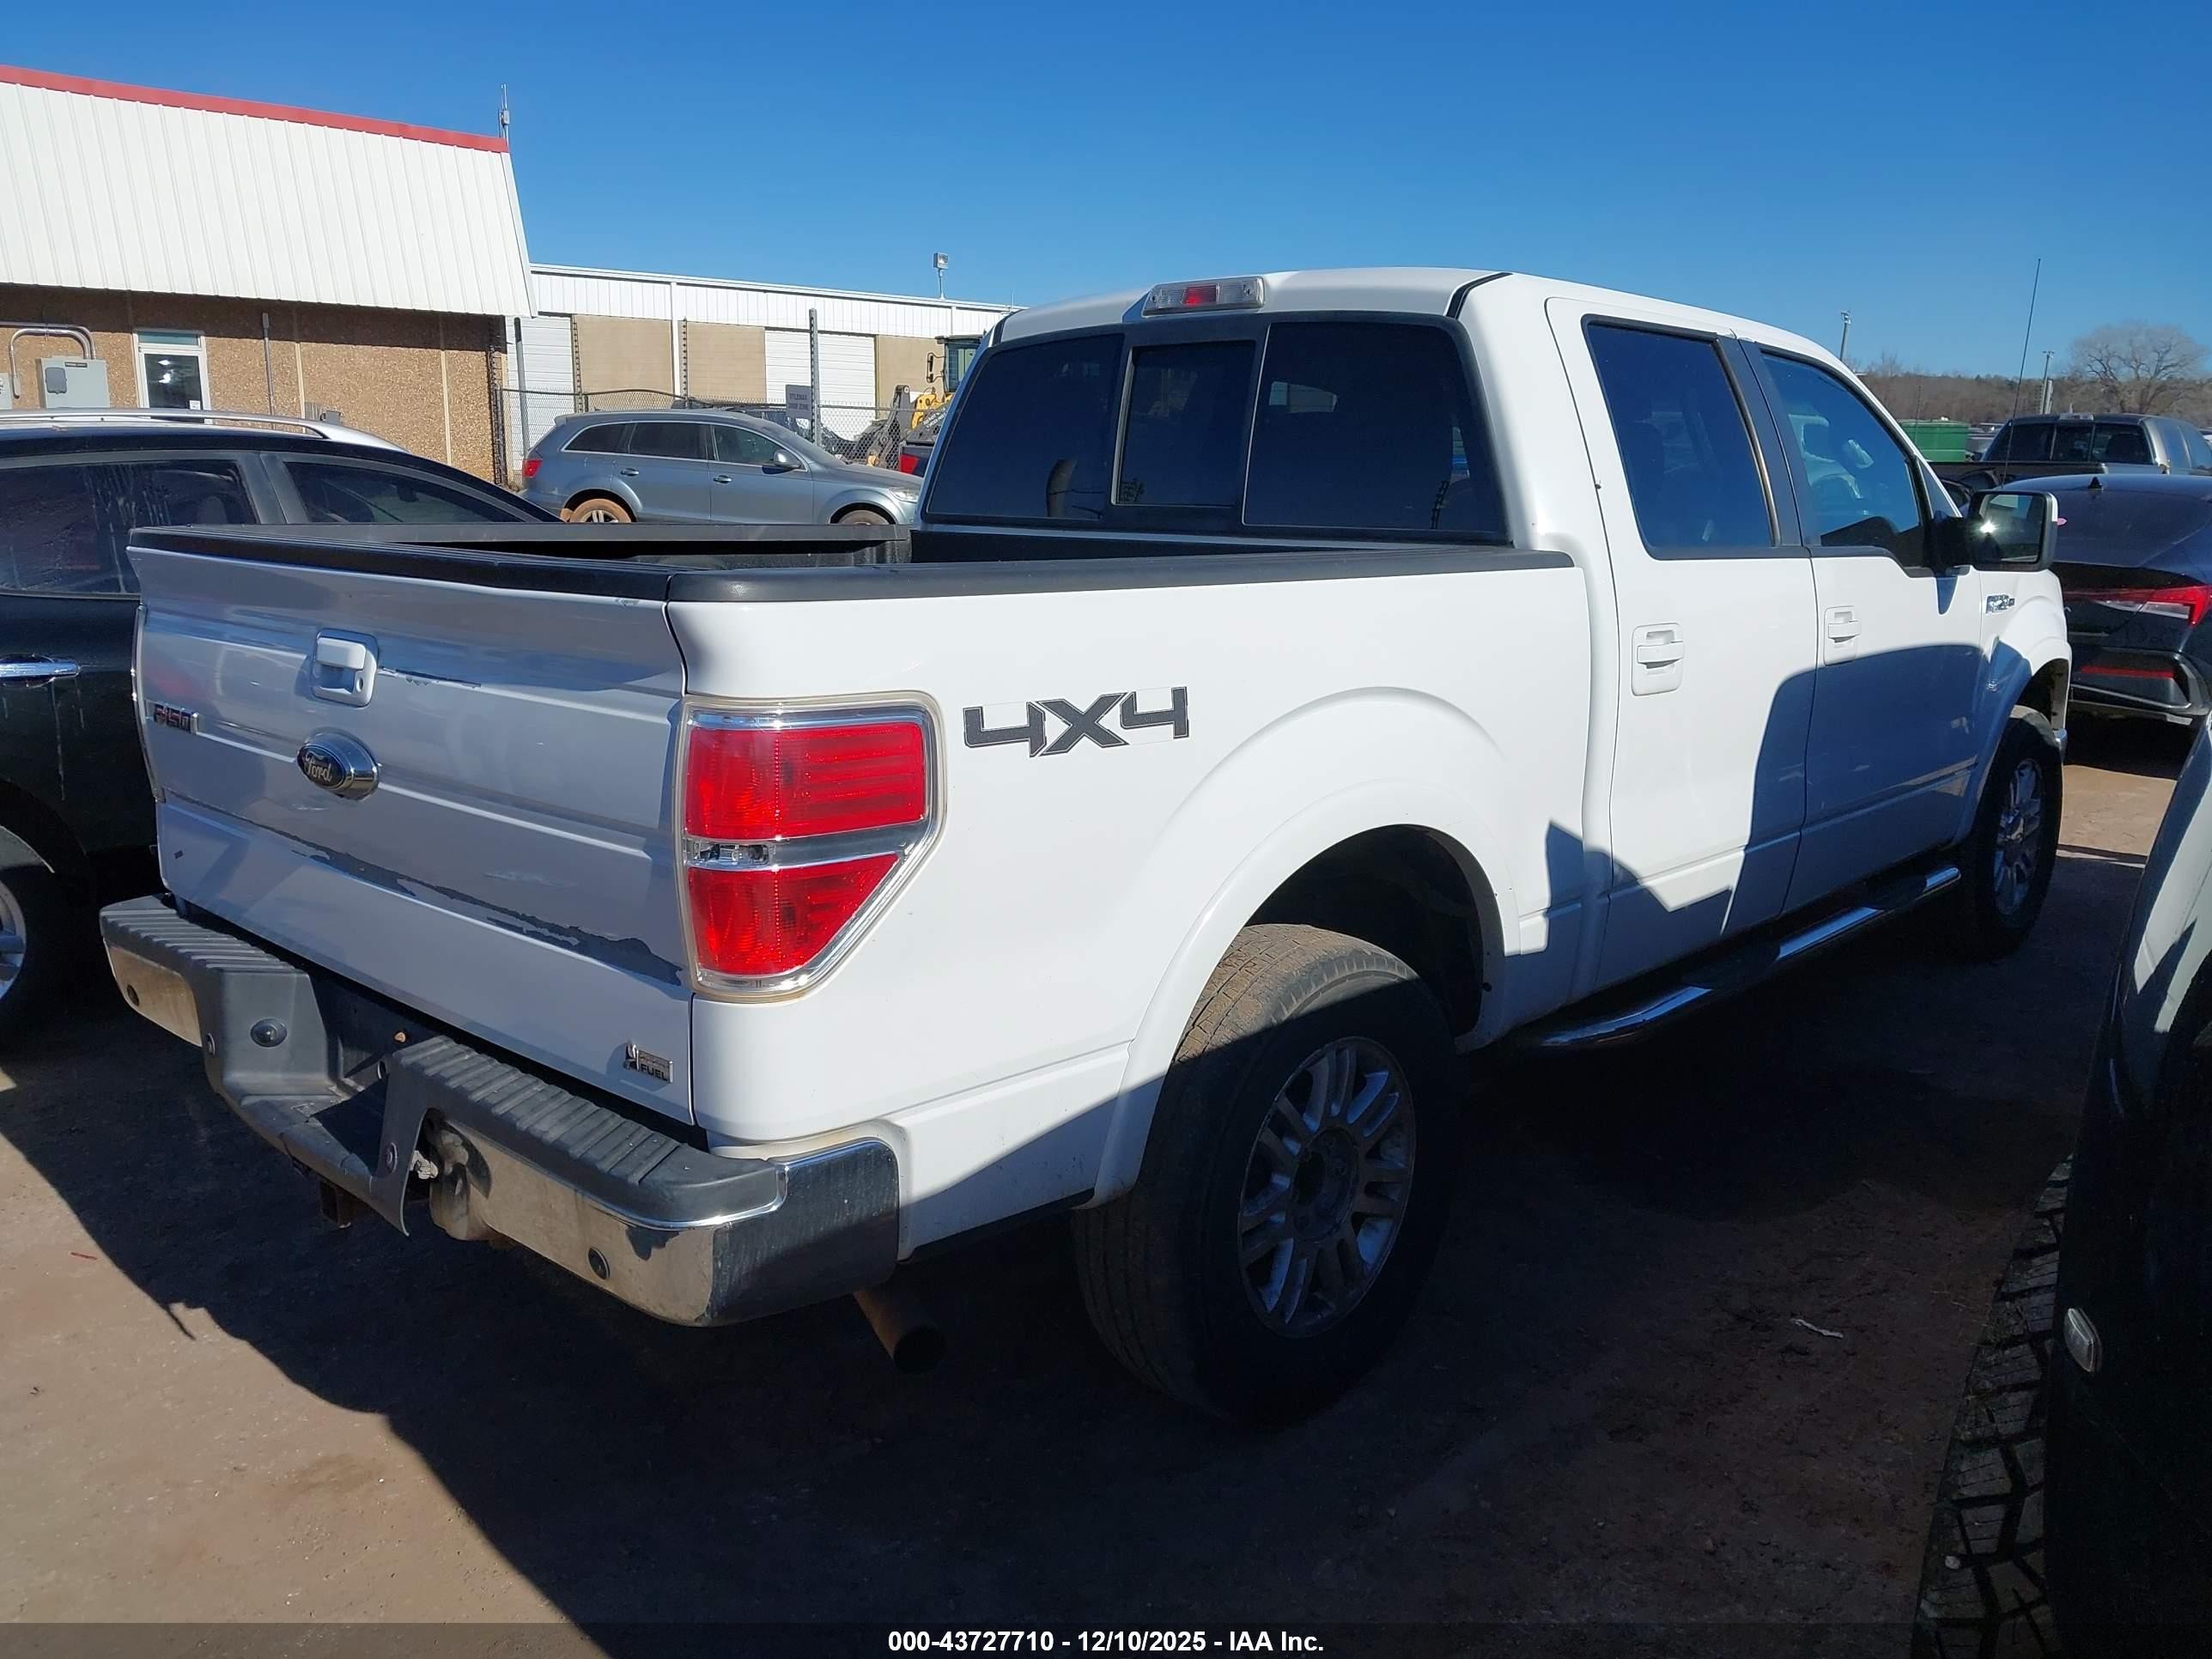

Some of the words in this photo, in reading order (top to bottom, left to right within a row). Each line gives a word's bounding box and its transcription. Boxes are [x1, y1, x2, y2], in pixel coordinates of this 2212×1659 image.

[963, 686, 1189, 757] 4X4
[304, 750, 333, 783] Ford
[640, 1062, 668, 1082] FUEL
